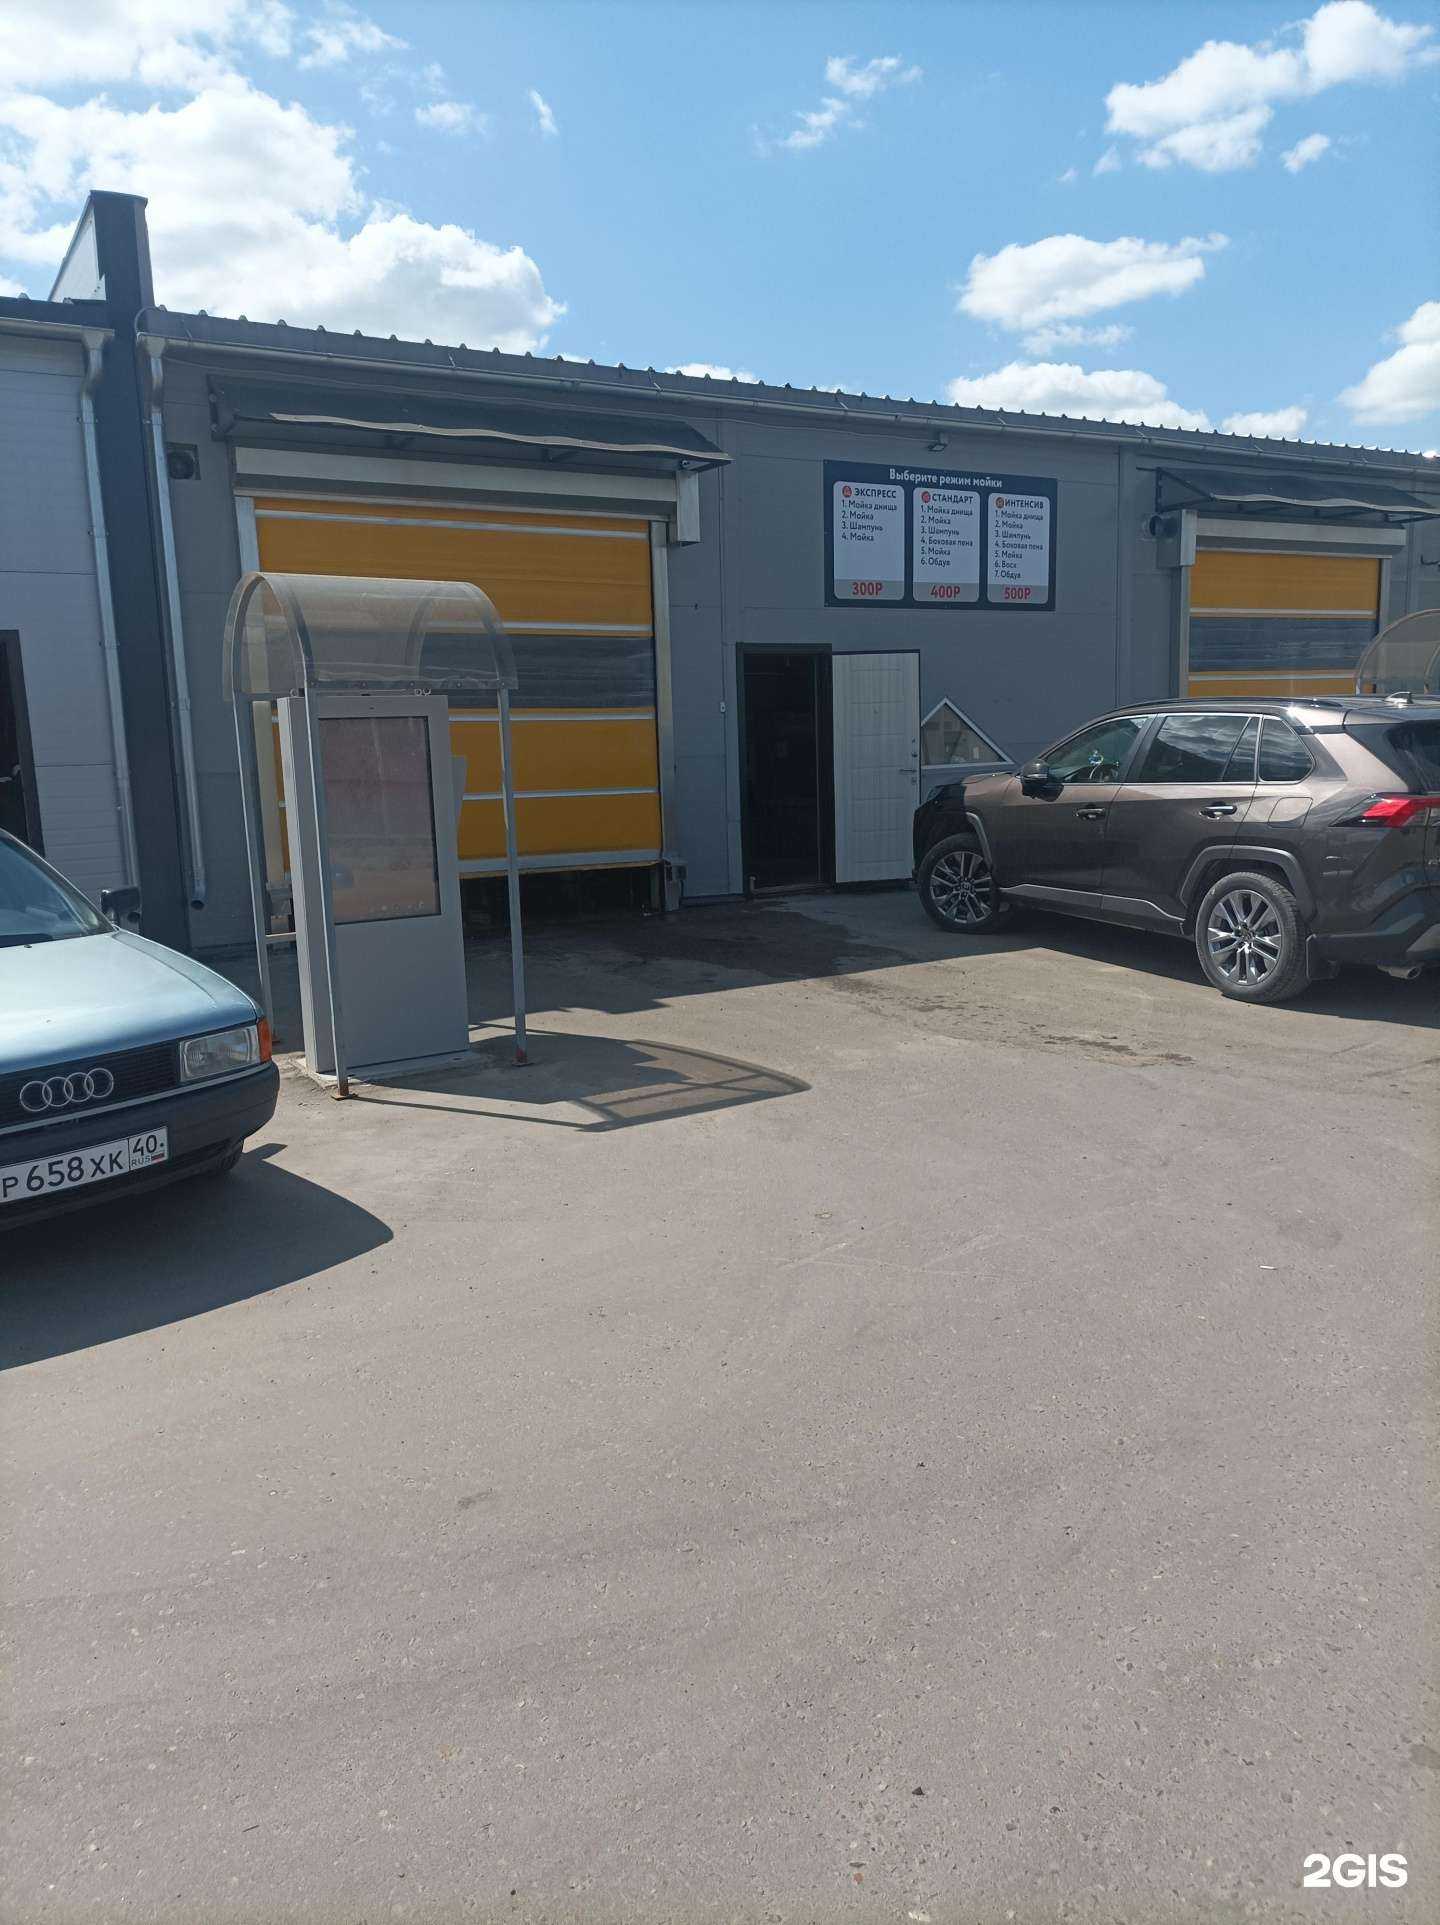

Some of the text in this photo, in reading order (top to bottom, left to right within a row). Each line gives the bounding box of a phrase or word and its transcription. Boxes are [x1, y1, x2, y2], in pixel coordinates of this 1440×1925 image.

[890, 468, 1003, 488] Выберите режим мойки
[854, 487, 897, 499] ЭКСПРЕСС
[932, 493, 973, 504] СТАНДАРТ
[842, 500, 897, 511] 1. Мойка днища
[1005, 498, 1044, 509] ИНТЕНСИВ
[842, 511, 874, 520] 2. Мойка
[920, 505, 973, 516] 1. Мойка днища
[995, 510, 999, 518] 1.
[1001, 510, 1022, 519] Мойка
[920, 515, 951, 525] 2. Мойка
[995, 520, 1023, 529] 2. Мойка
[842, 521, 883, 532] 3. Шампунь
[920, 526, 959, 536] 3. Шампунь
[842, 532, 874, 541] 4. Мойка
[995, 529, 1031, 541] 3. Шампунь
[920, 536, 973, 547] 4. Боковая пена
[995, 540, 1000, 548] 4.
[920, 547, 951, 556] 5. Мойка
[994, 550, 1023, 559] 5. Мойка
[920, 557, 950, 568] 6. Обдув
[1001, 561, 1017, 569] Воск
[995, 570, 999, 578] 7.
[132, 1134, 158, 1157] 40
[131, 1155, 151, 1168] RUS
